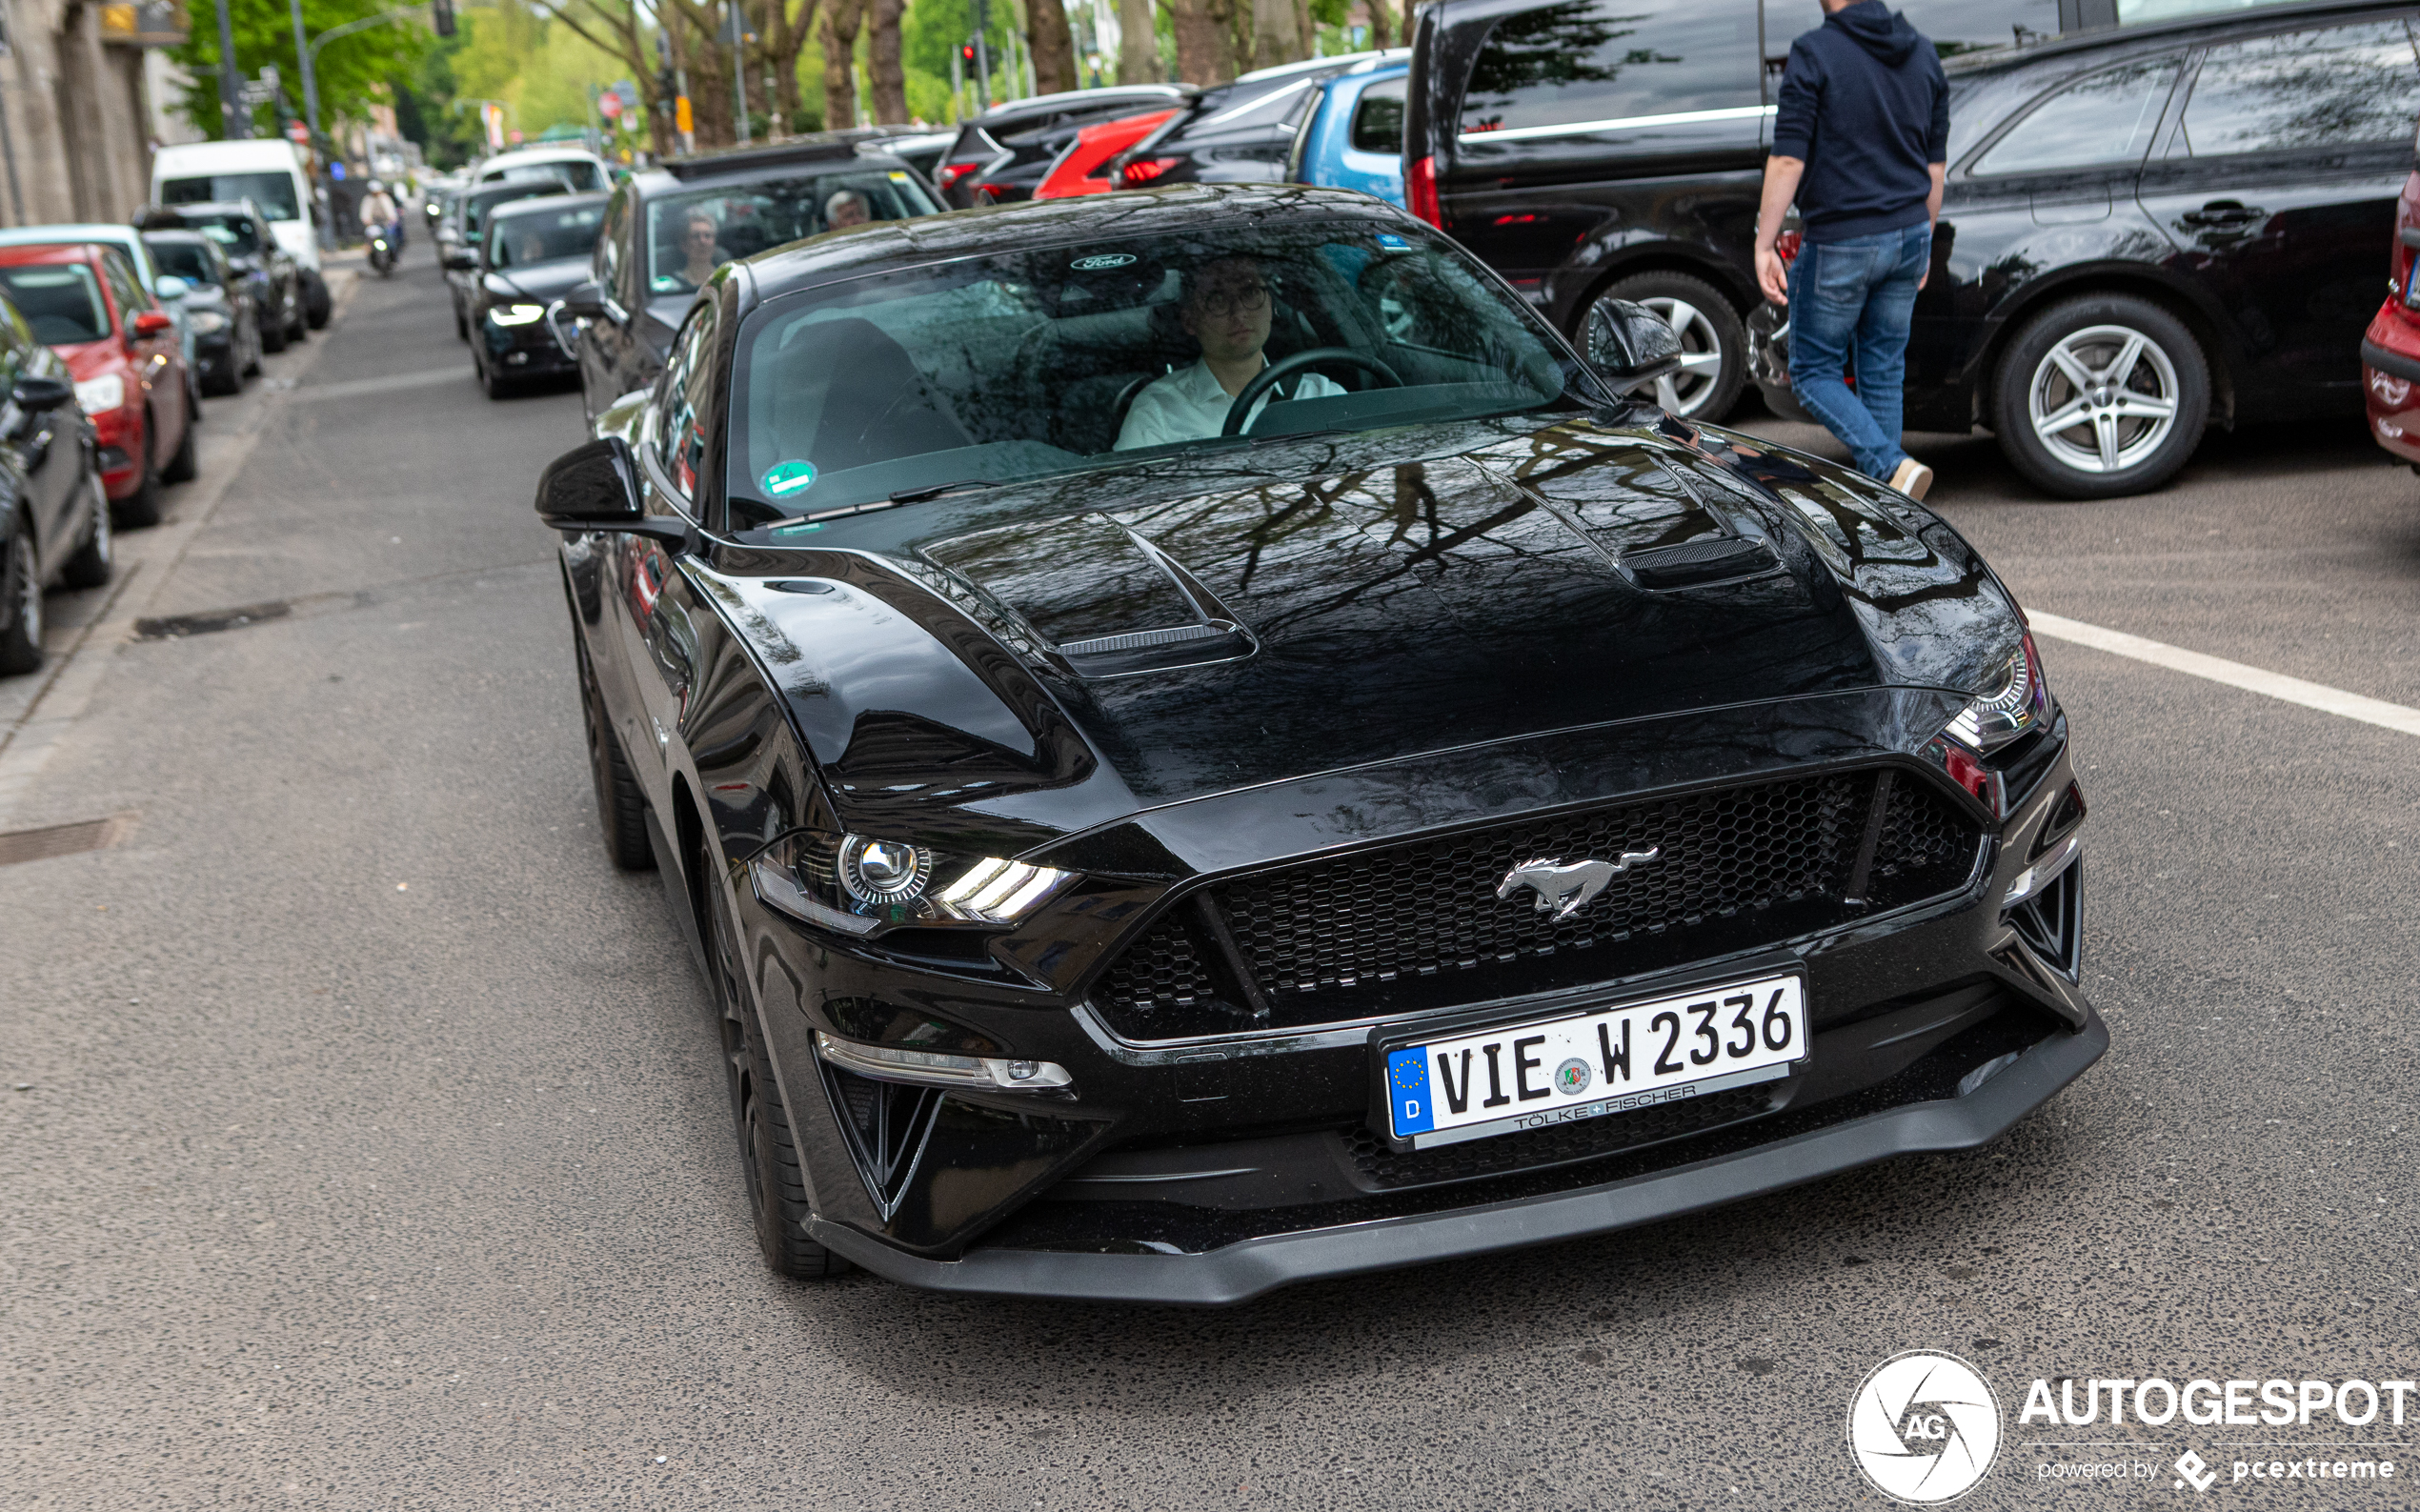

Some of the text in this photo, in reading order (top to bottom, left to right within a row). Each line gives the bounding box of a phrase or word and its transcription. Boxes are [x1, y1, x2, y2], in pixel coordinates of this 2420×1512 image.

[1082, 255, 1125, 270] Ford
[1404, 987, 1792, 1119] D VIE W 2336
